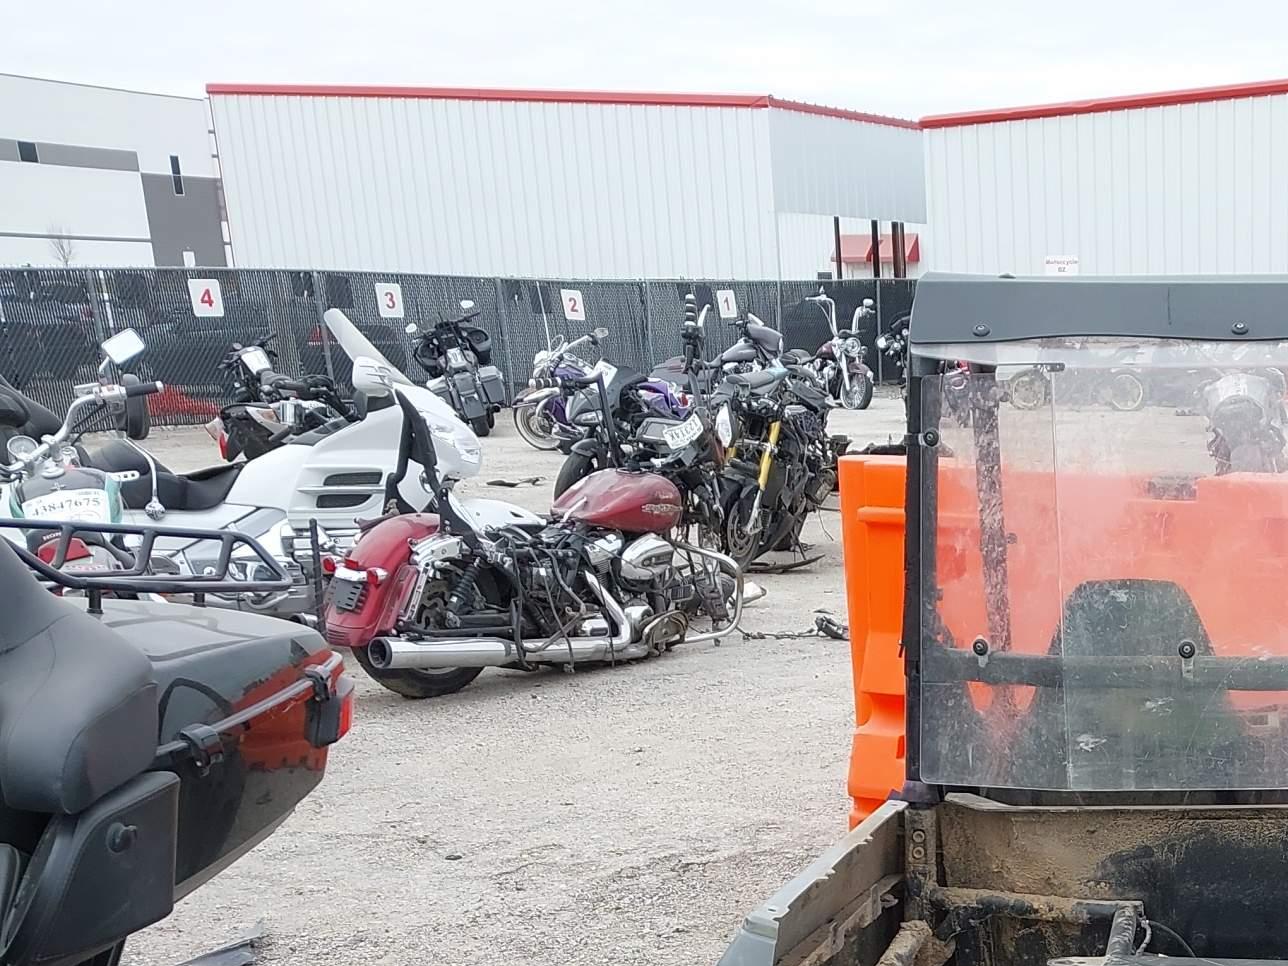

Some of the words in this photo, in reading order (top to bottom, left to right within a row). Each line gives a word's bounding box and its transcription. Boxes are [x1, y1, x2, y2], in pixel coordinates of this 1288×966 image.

[200, 288, 214, 308] 4
[384, 291, 396, 309] 3
[568, 297, 579, 312] 2
[723, 296, 731, 311] 1
